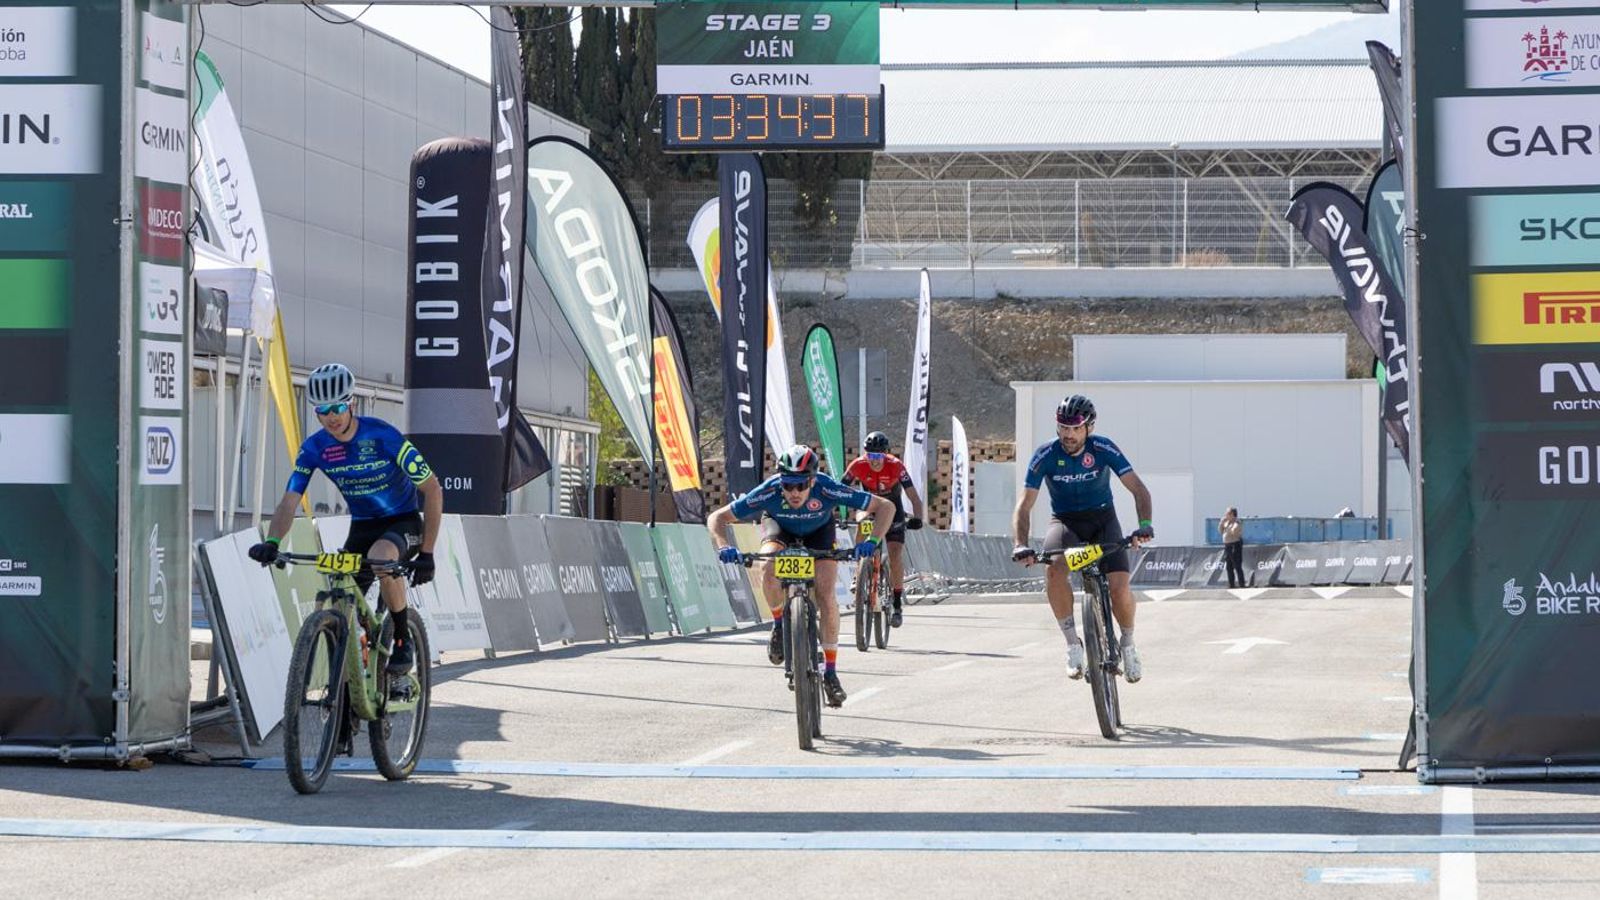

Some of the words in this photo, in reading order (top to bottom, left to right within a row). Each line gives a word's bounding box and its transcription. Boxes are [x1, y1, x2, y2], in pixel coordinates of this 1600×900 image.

[706, 14, 800, 31] STAGE
[811, 14, 831, 31] 3
[1, 28, 25, 43] ión
[744, 36, 793, 58] JAÉN
[1571, 55, 1586, 71] DE
[1590, 55, 1600, 70] C
[730, 73, 810, 86] GARMIN
[677, 93, 868, 141] 03:34:37
[141, 120, 186, 153] GRMIN
[1487, 124, 1600, 158] GAR
[1539, 445, 1600, 485] GO
[778, 558, 812, 575] 238-2
[1145, 561, 1185, 571] GARMIN
[0, 582, 36, 590] ARMIN
[479, 567, 523, 600] GARMIN
[523, 562, 556, 594] GARMIN
[559, 565, 598, 594] GARMIN
[601, 565, 635, 593] GARMIN
[1536, 596, 1581, 614] BIKE
